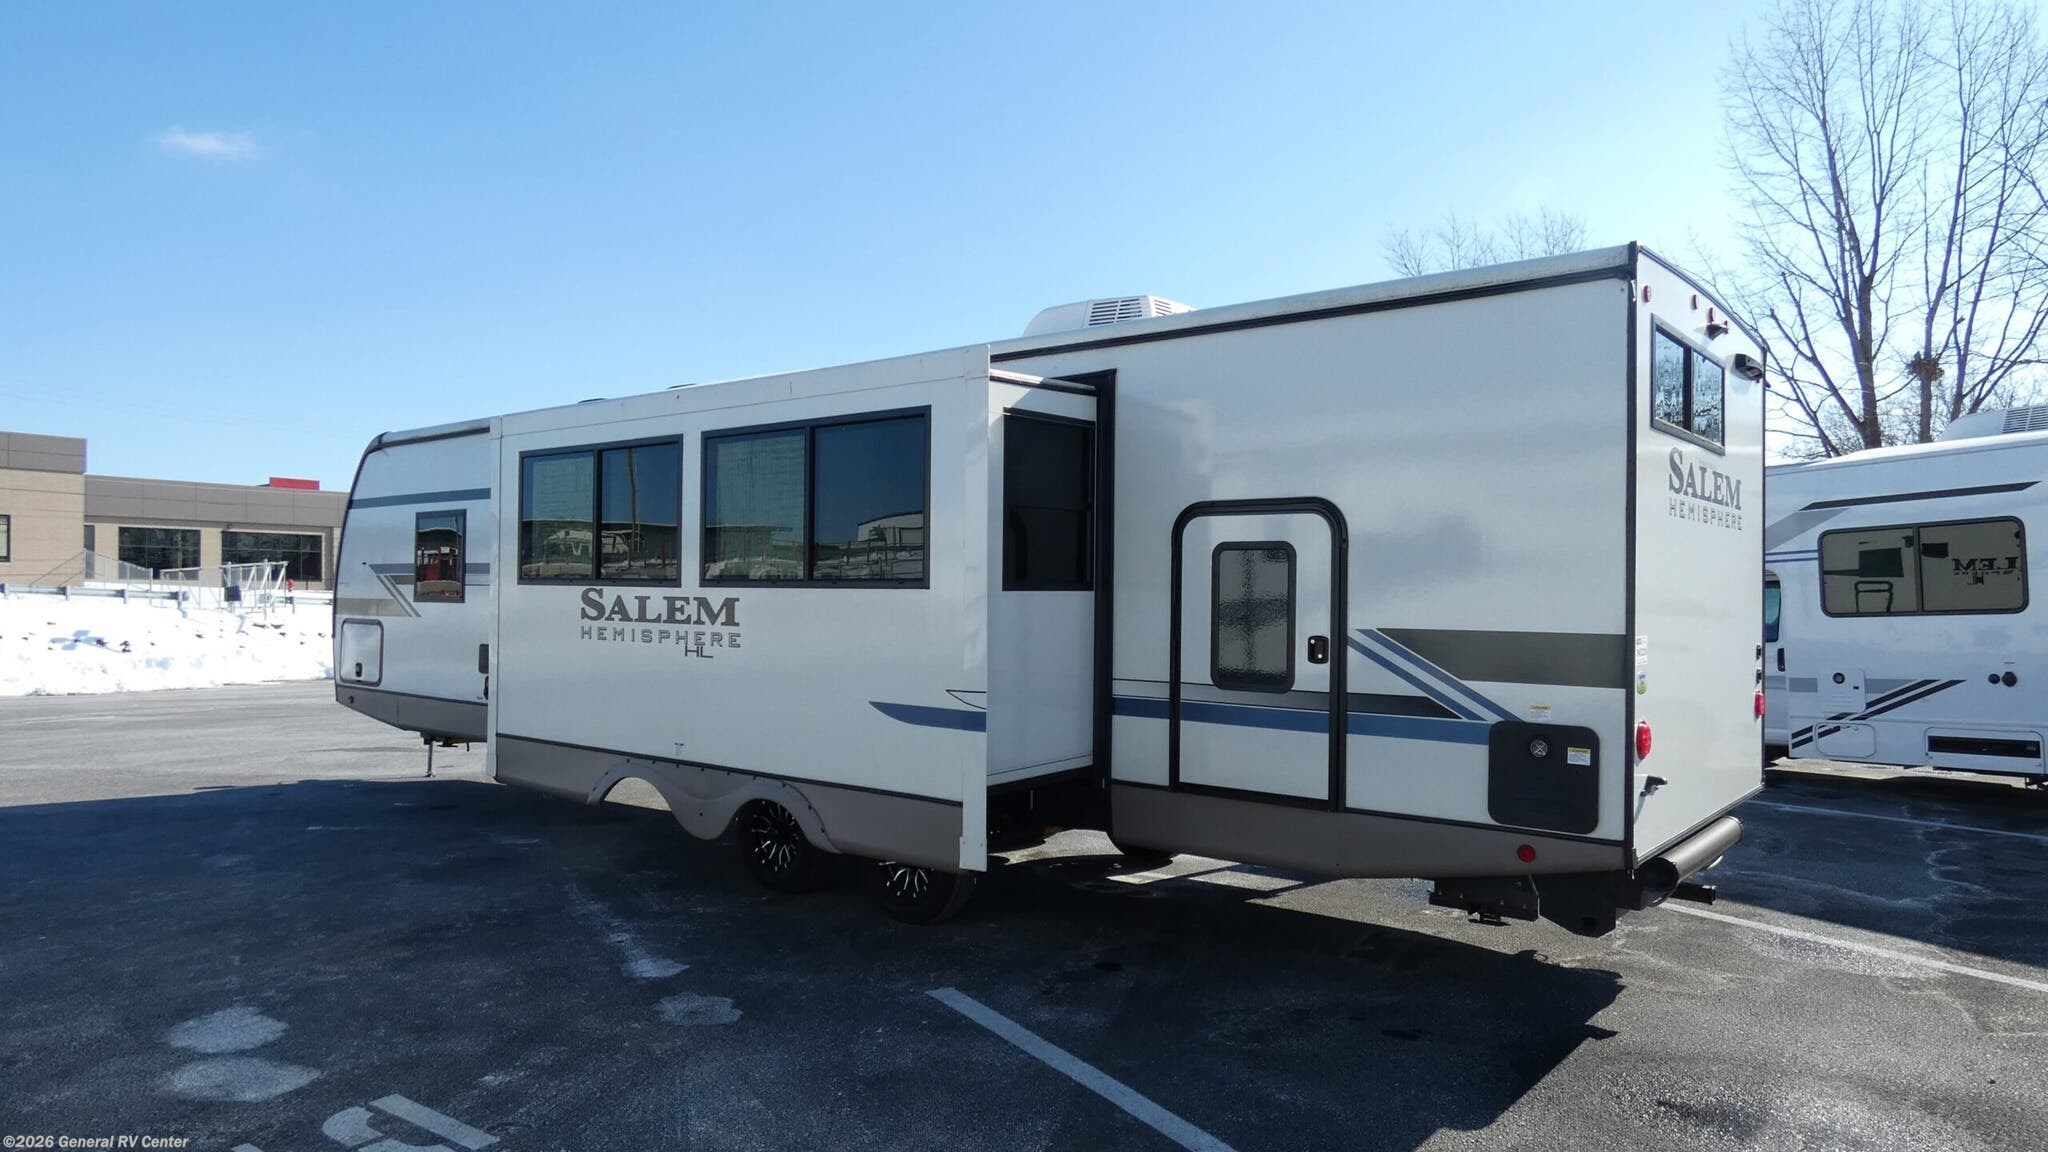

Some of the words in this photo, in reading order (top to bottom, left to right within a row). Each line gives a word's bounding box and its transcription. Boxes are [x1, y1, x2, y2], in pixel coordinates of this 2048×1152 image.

[1669, 447, 1742, 510] SALEM
[1669, 497, 1742, 531] HEMISPHERE
[581, 587, 740, 627] SALEM
[581, 626, 741, 648] HEMISPHERE
[684, 644, 714, 659] HL
